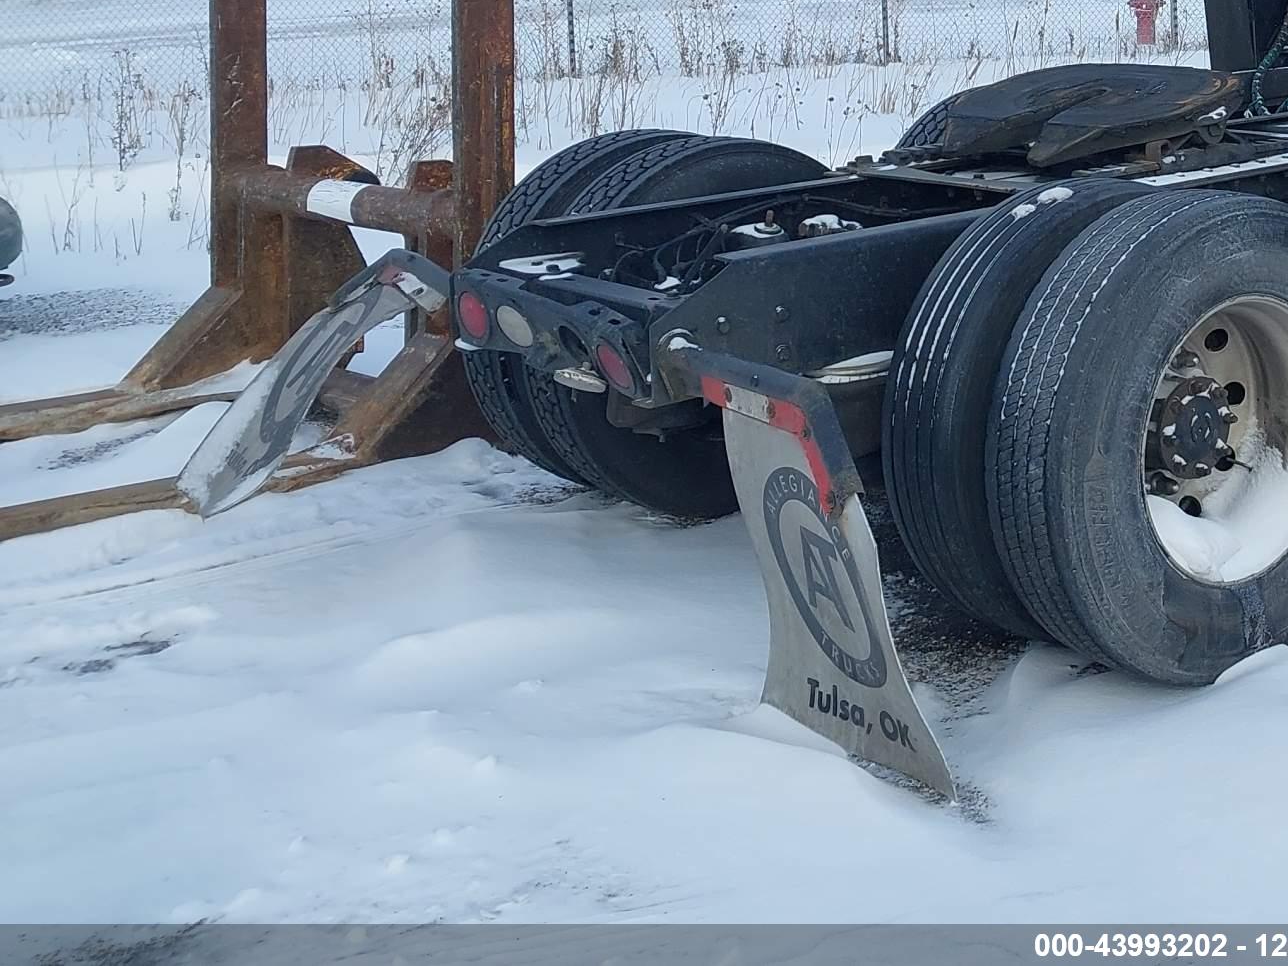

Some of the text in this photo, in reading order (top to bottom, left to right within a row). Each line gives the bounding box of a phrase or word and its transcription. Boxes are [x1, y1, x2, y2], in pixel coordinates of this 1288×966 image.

[821, 630, 880, 681] TRUCKS
[807, 677, 918, 753] Tulsa, OK
